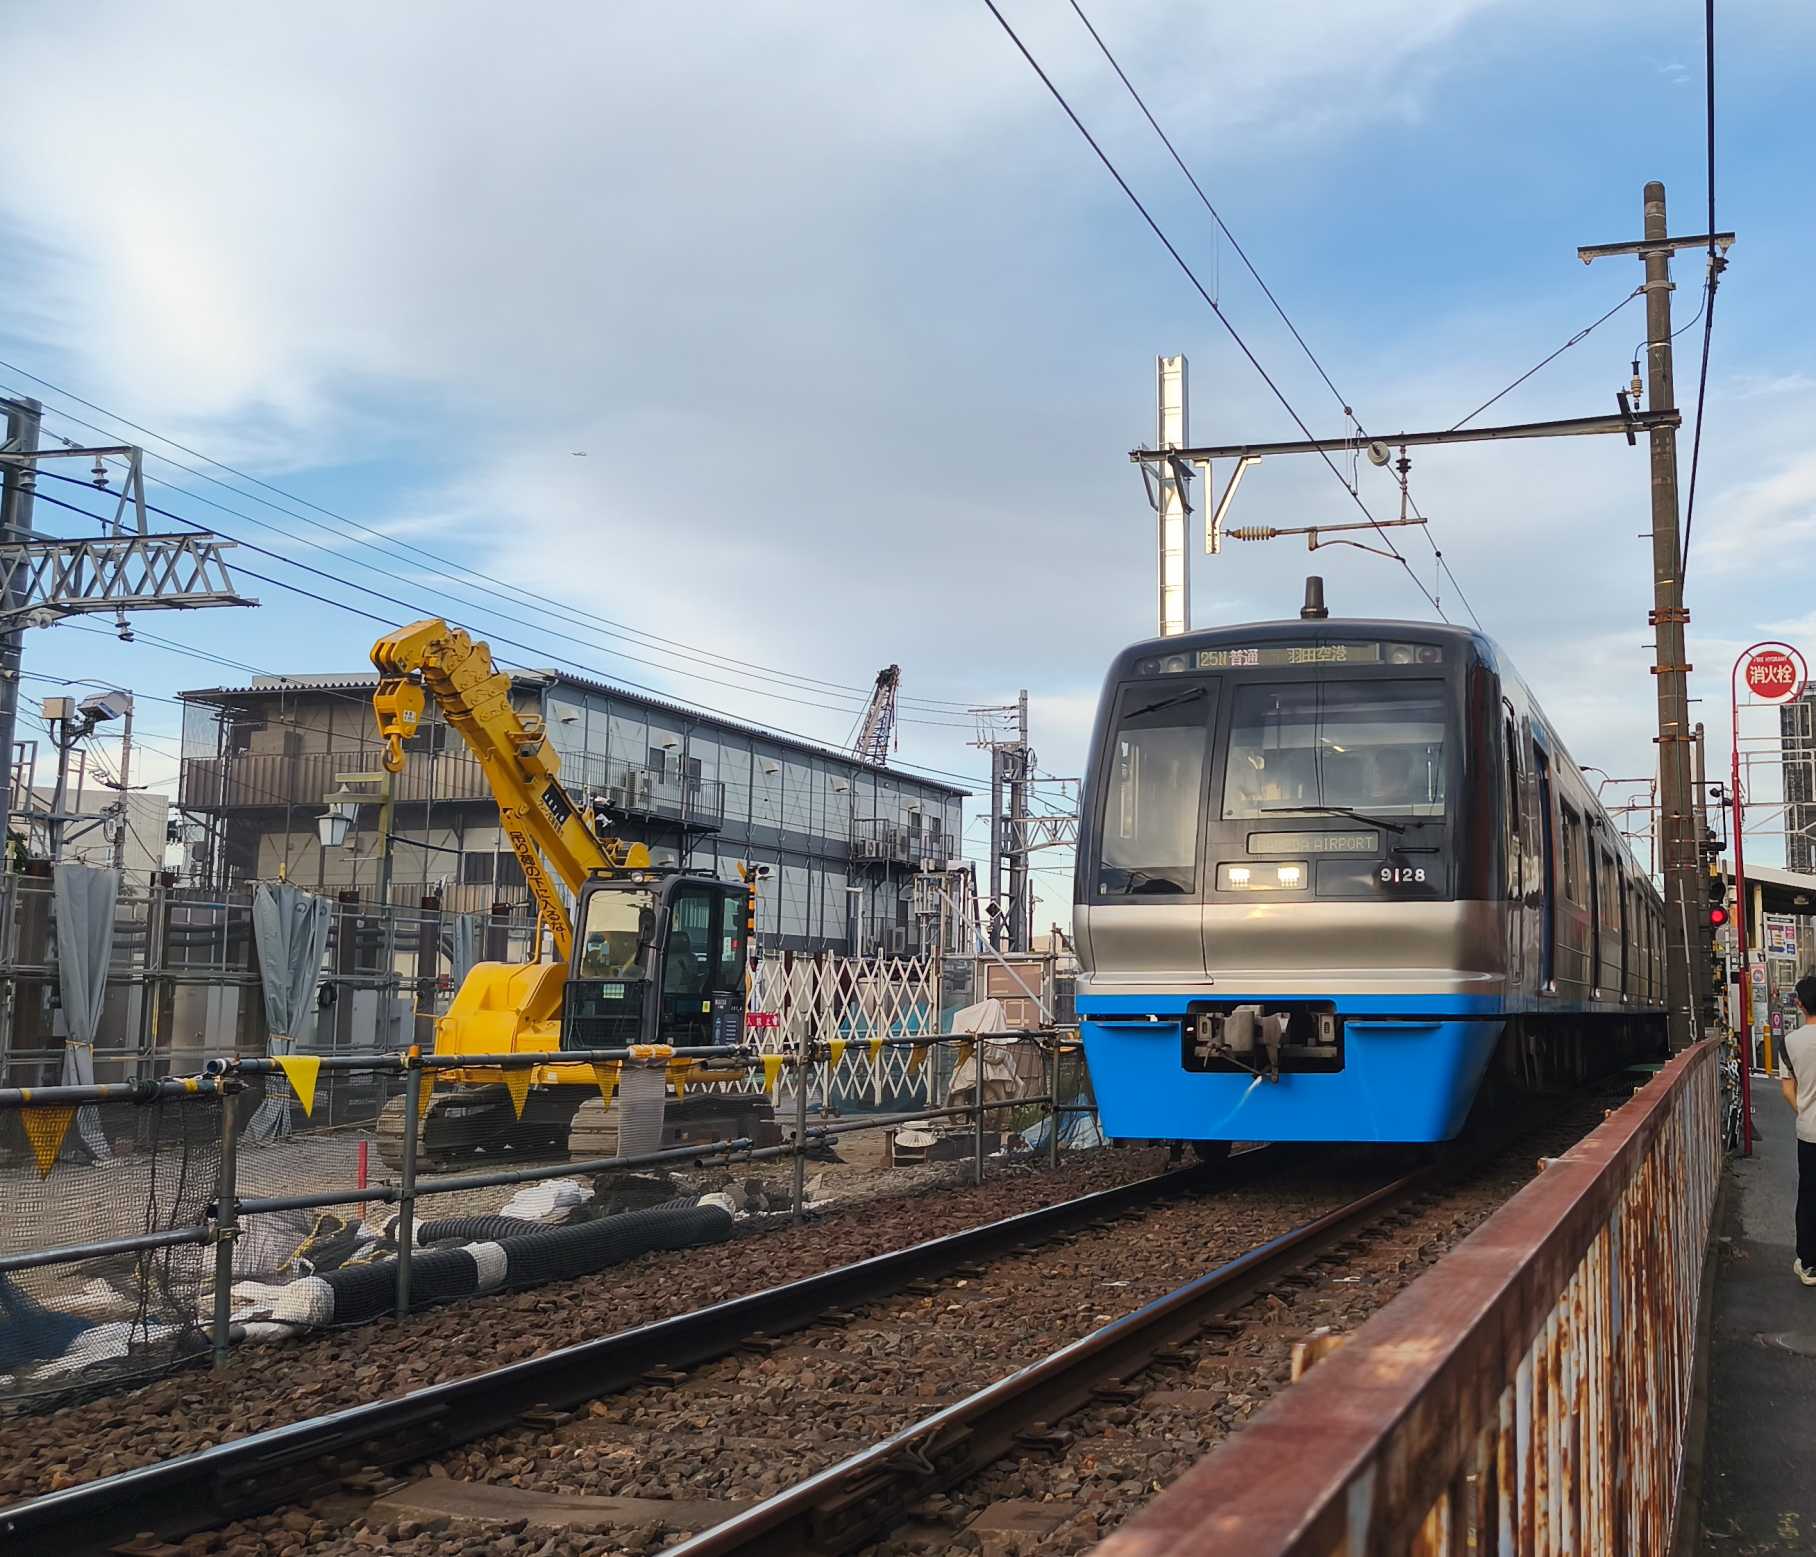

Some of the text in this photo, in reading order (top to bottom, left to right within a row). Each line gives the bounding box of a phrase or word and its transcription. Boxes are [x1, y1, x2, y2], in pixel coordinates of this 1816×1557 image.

[1229, 649, 1260, 666] 普通
[1286, 645, 1347, 664] 羽田空港
[1750, 664, 1793, 685] 消火栓
[1313, 836, 1373, 851] AIRPORT
[1380, 867, 1426, 883] 9128
